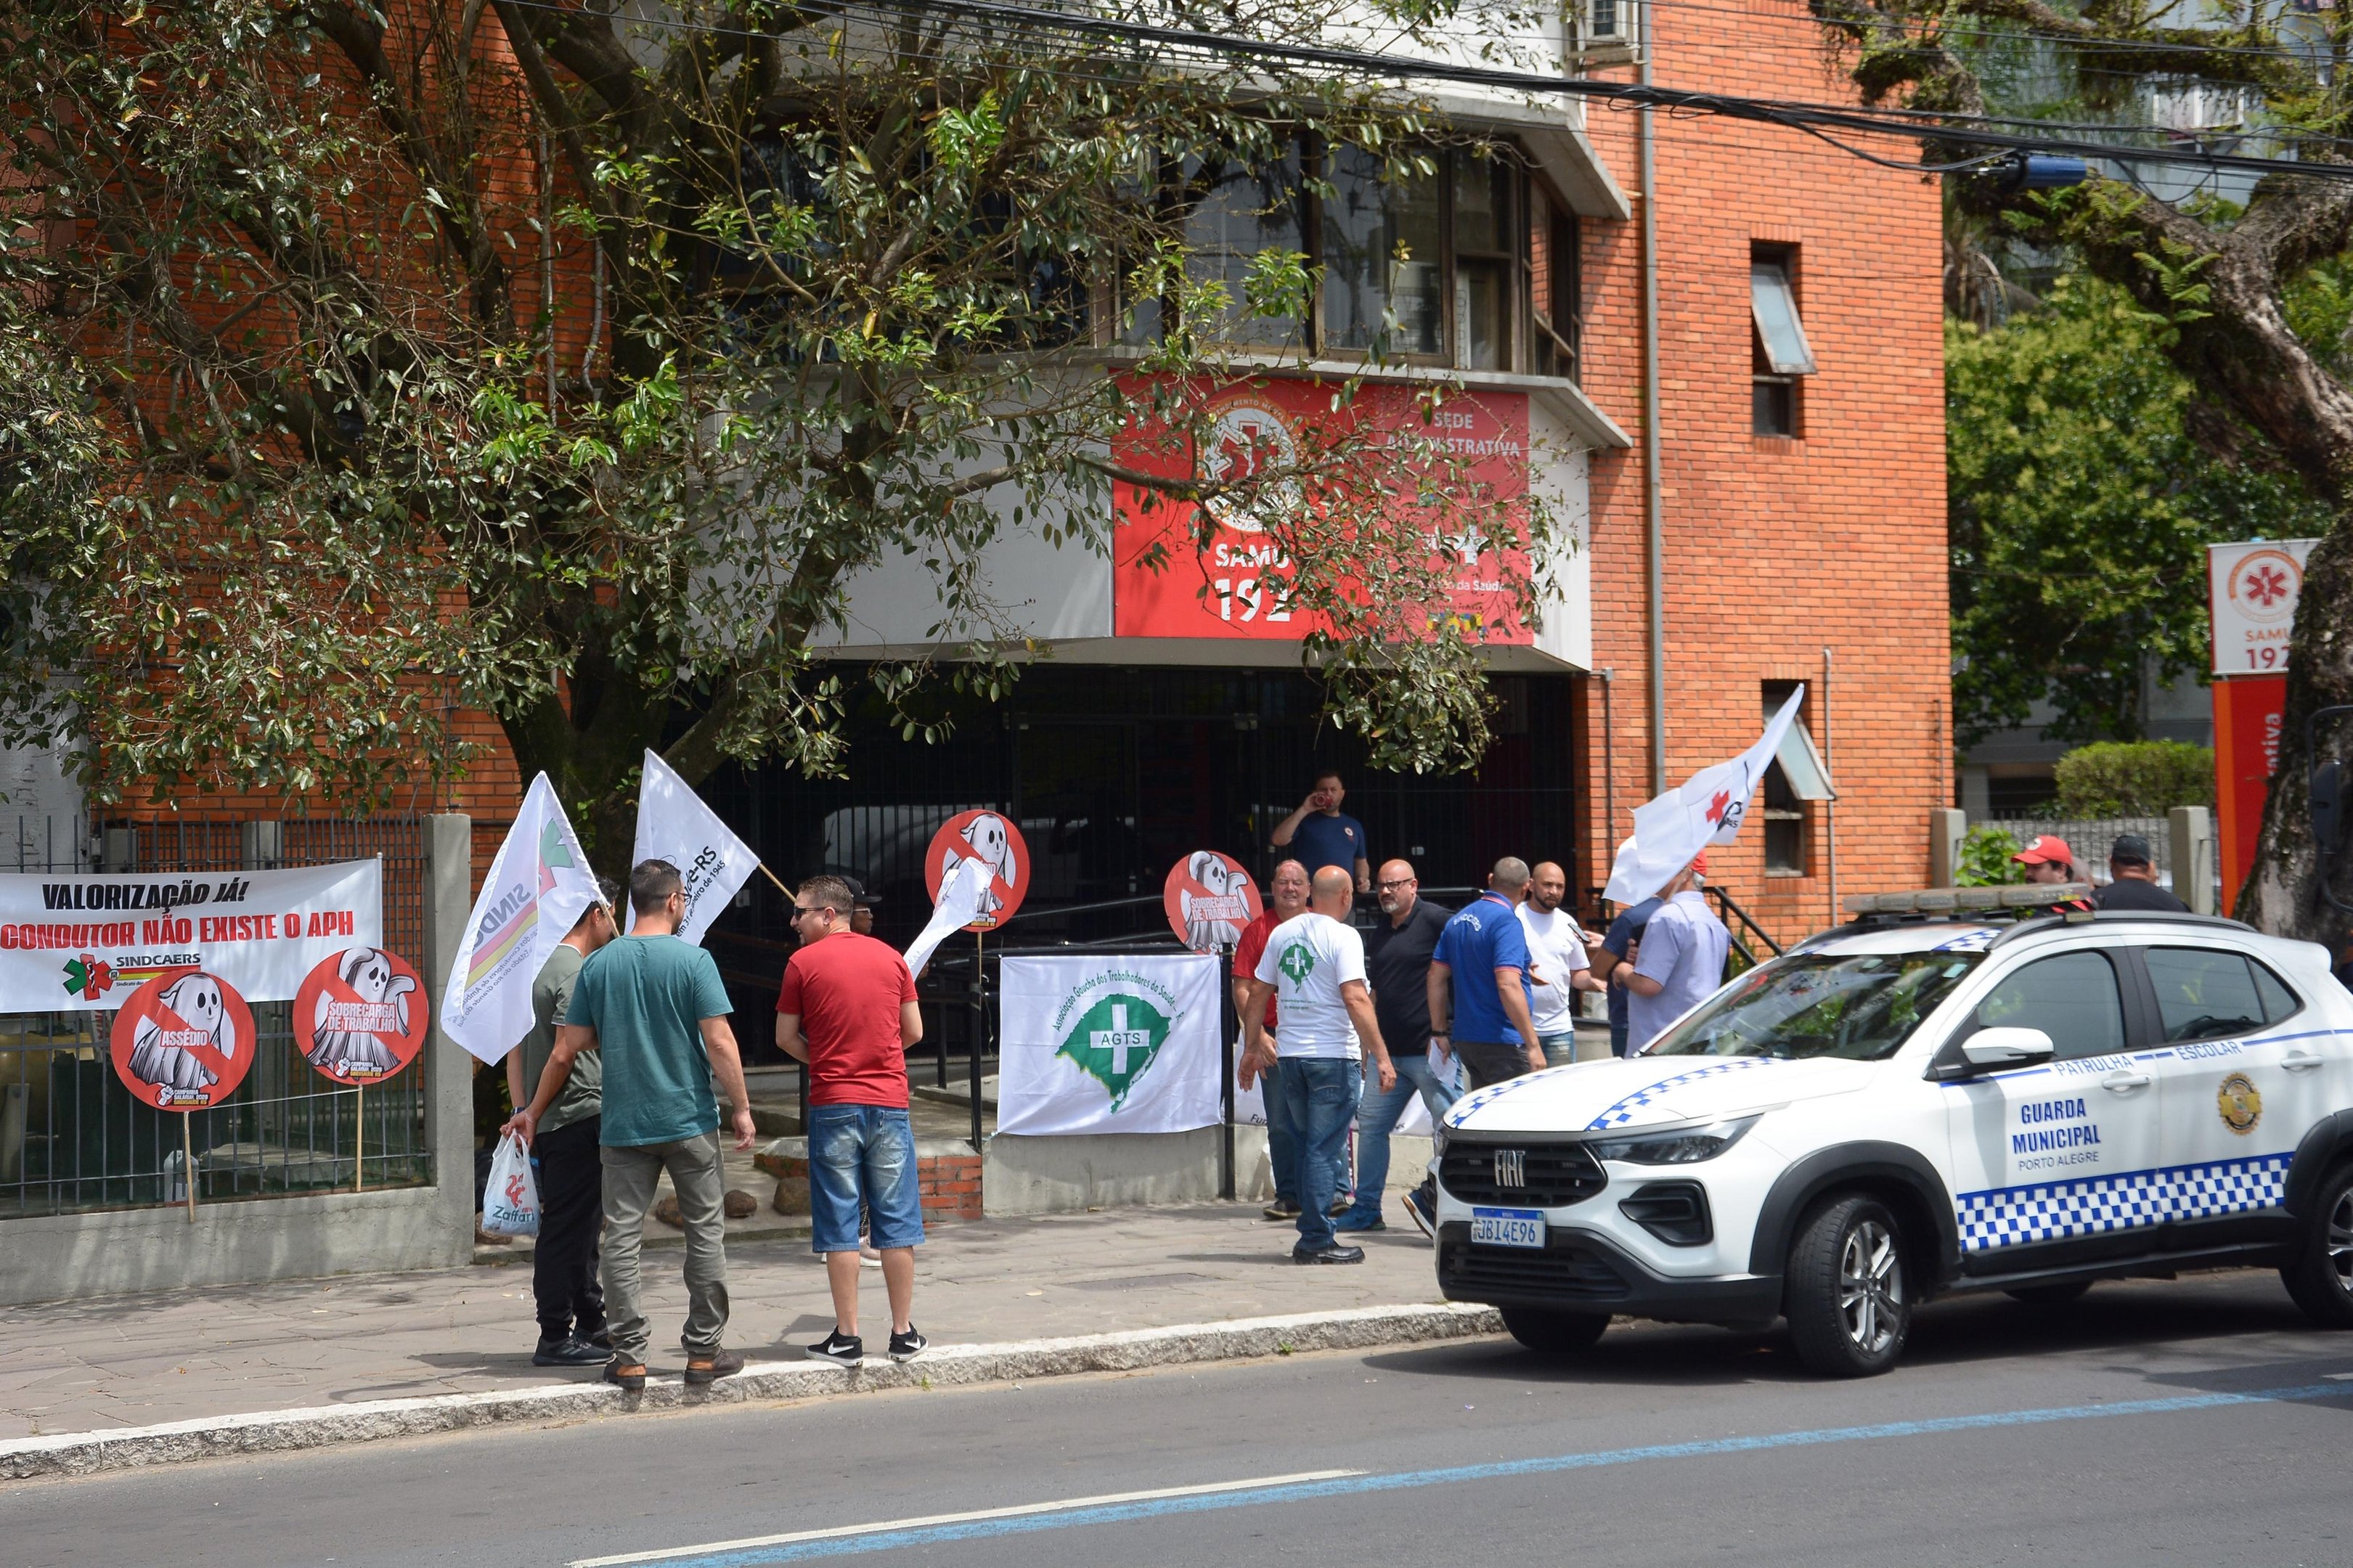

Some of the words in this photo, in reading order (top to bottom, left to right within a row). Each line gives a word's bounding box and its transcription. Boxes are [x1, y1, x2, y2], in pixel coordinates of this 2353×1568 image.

[1434, 412, 1473, 430] SEDE
[42, 879, 211, 914] VALORIZAÇÃO
[212, 877, 250, 903] JÁ!
[676, 925, 687, 937] em
[703, 877, 713, 887] de
[710, 859, 726, 878] 1945
[1191, 896, 1238, 910] SOBRECARGA
[1191, 908, 1204, 920] DE
[1203, 907, 1242, 920] TRABALHO
[1, 922, 135, 950] CONDUTOR
[143, 914, 192, 945] NÃO
[199, 913, 277, 943] EXISTE
[284, 913, 301, 939] O
[307, 910, 354, 937] APH
[116, 953, 201, 968] SINDCAERS
[328, 1002, 396, 1018] SOBRECARGA
[1052, 995, 1076, 1032] Associação
[1096, 973, 1107, 985] dos
[1107, 970, 1150, 987] Trabalhadores
[1150, 980, 1159, 992] da
[1158, 985, 1175, 1007] Saúde
[327, 1016, 341, 1031] DE
[343, 1017, 396, 1032] TRABALHO
[161, 1028, 208, 1046] ASSÉDIO
[1101, 1033, 1141, 1046] AGTS
[2054, 1055, 2134, 1077] PATRULHA
[2176, 1041, 2242, 1061] ESCOLAR
[2020, 1098, 2087, 1124] GUARDA
[2013, 1124, 2101, 1154] MUNICIPAL
[1495, 1150, 1525, 1187] FIAT
[2018, 1156, 2055, 1172] PORTO
[2056, 1151, 2100, 1168] ALEGRE
[493, 1206, 534, 1223] Zaffari
[1477, 1220, 1536, 1244] JBI4E96
